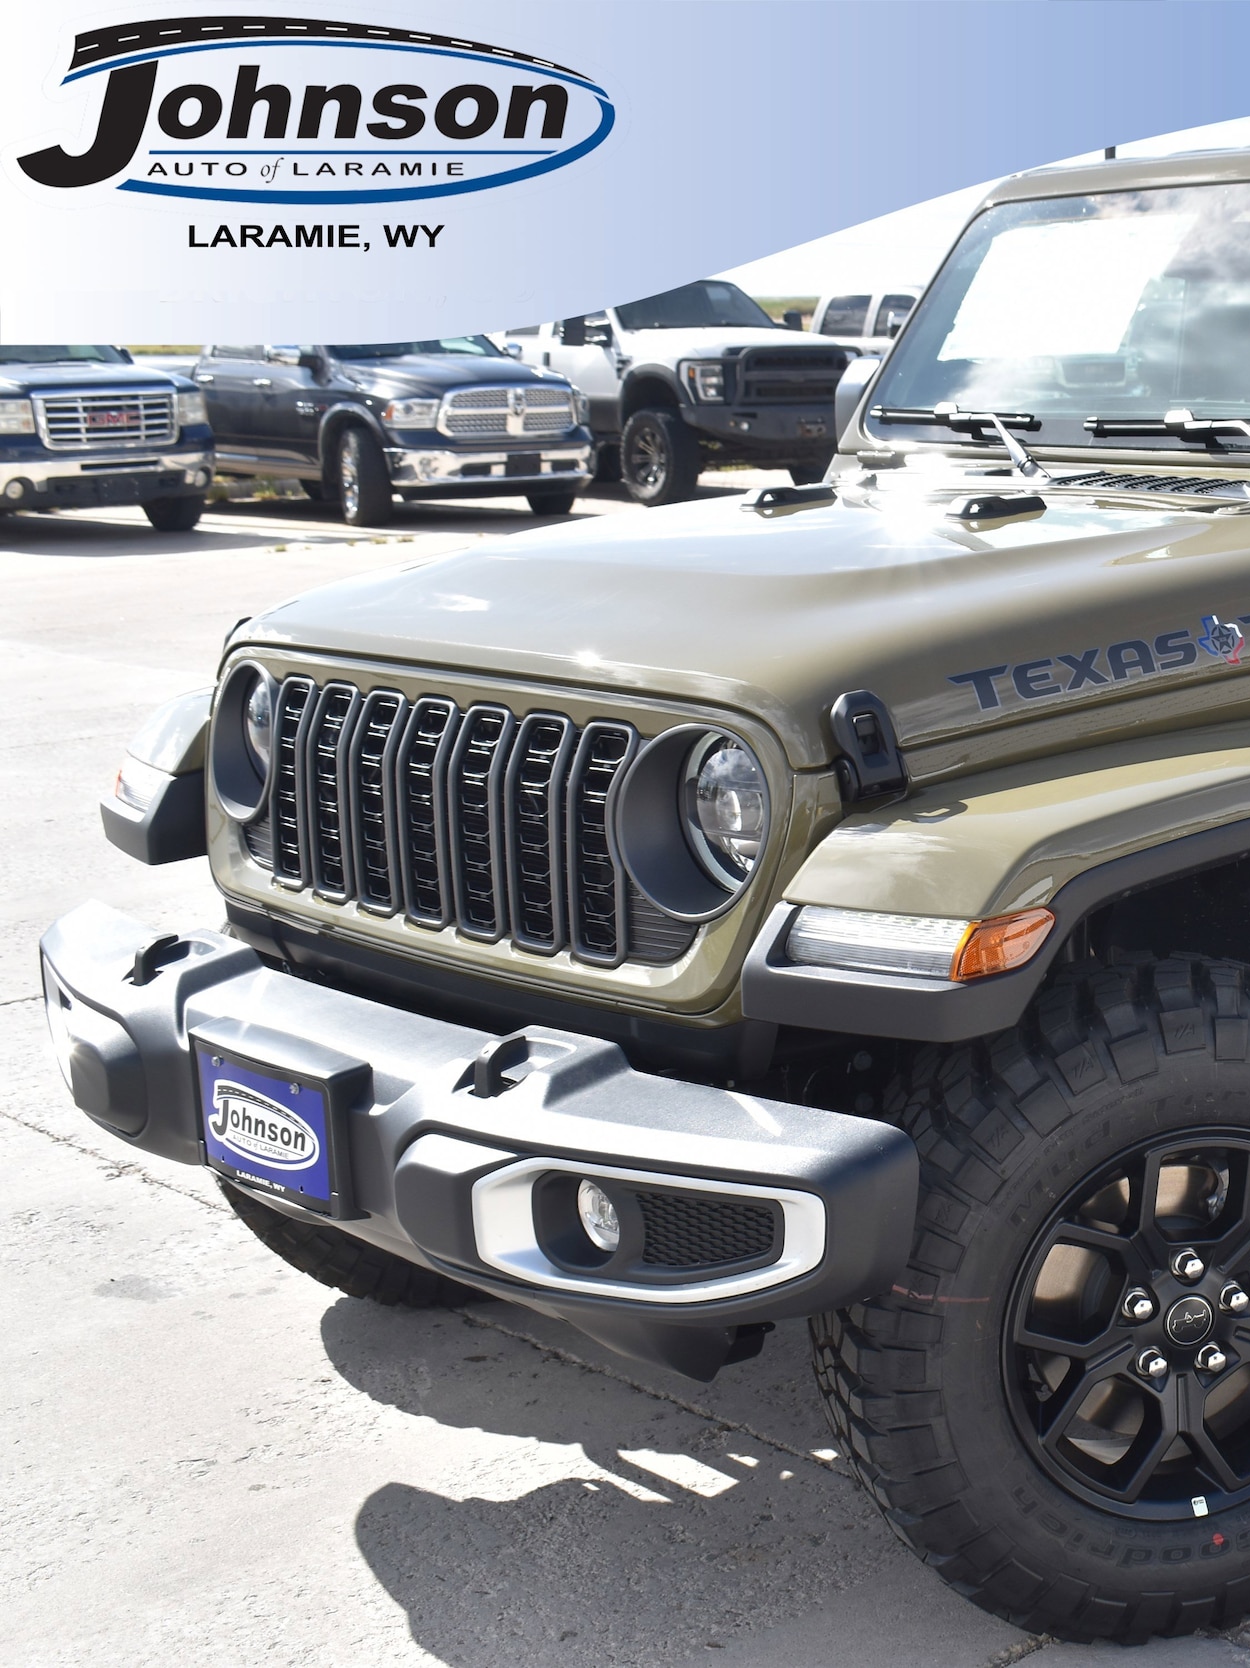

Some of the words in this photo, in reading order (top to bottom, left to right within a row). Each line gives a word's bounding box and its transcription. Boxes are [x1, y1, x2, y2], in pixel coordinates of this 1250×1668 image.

[87, 411, 141, 427] GMC
[946, 630, 1198, 712] TEXAS
[212, 1099, 306, 1152] Johnson
[232, 1134, 251, 1148] AUTO
[260, 1144, 289, 1159] LARAMIE
[236, 1170, 273, 1189] LARAMIE,
[273, 1182, 286, 1192] WY
